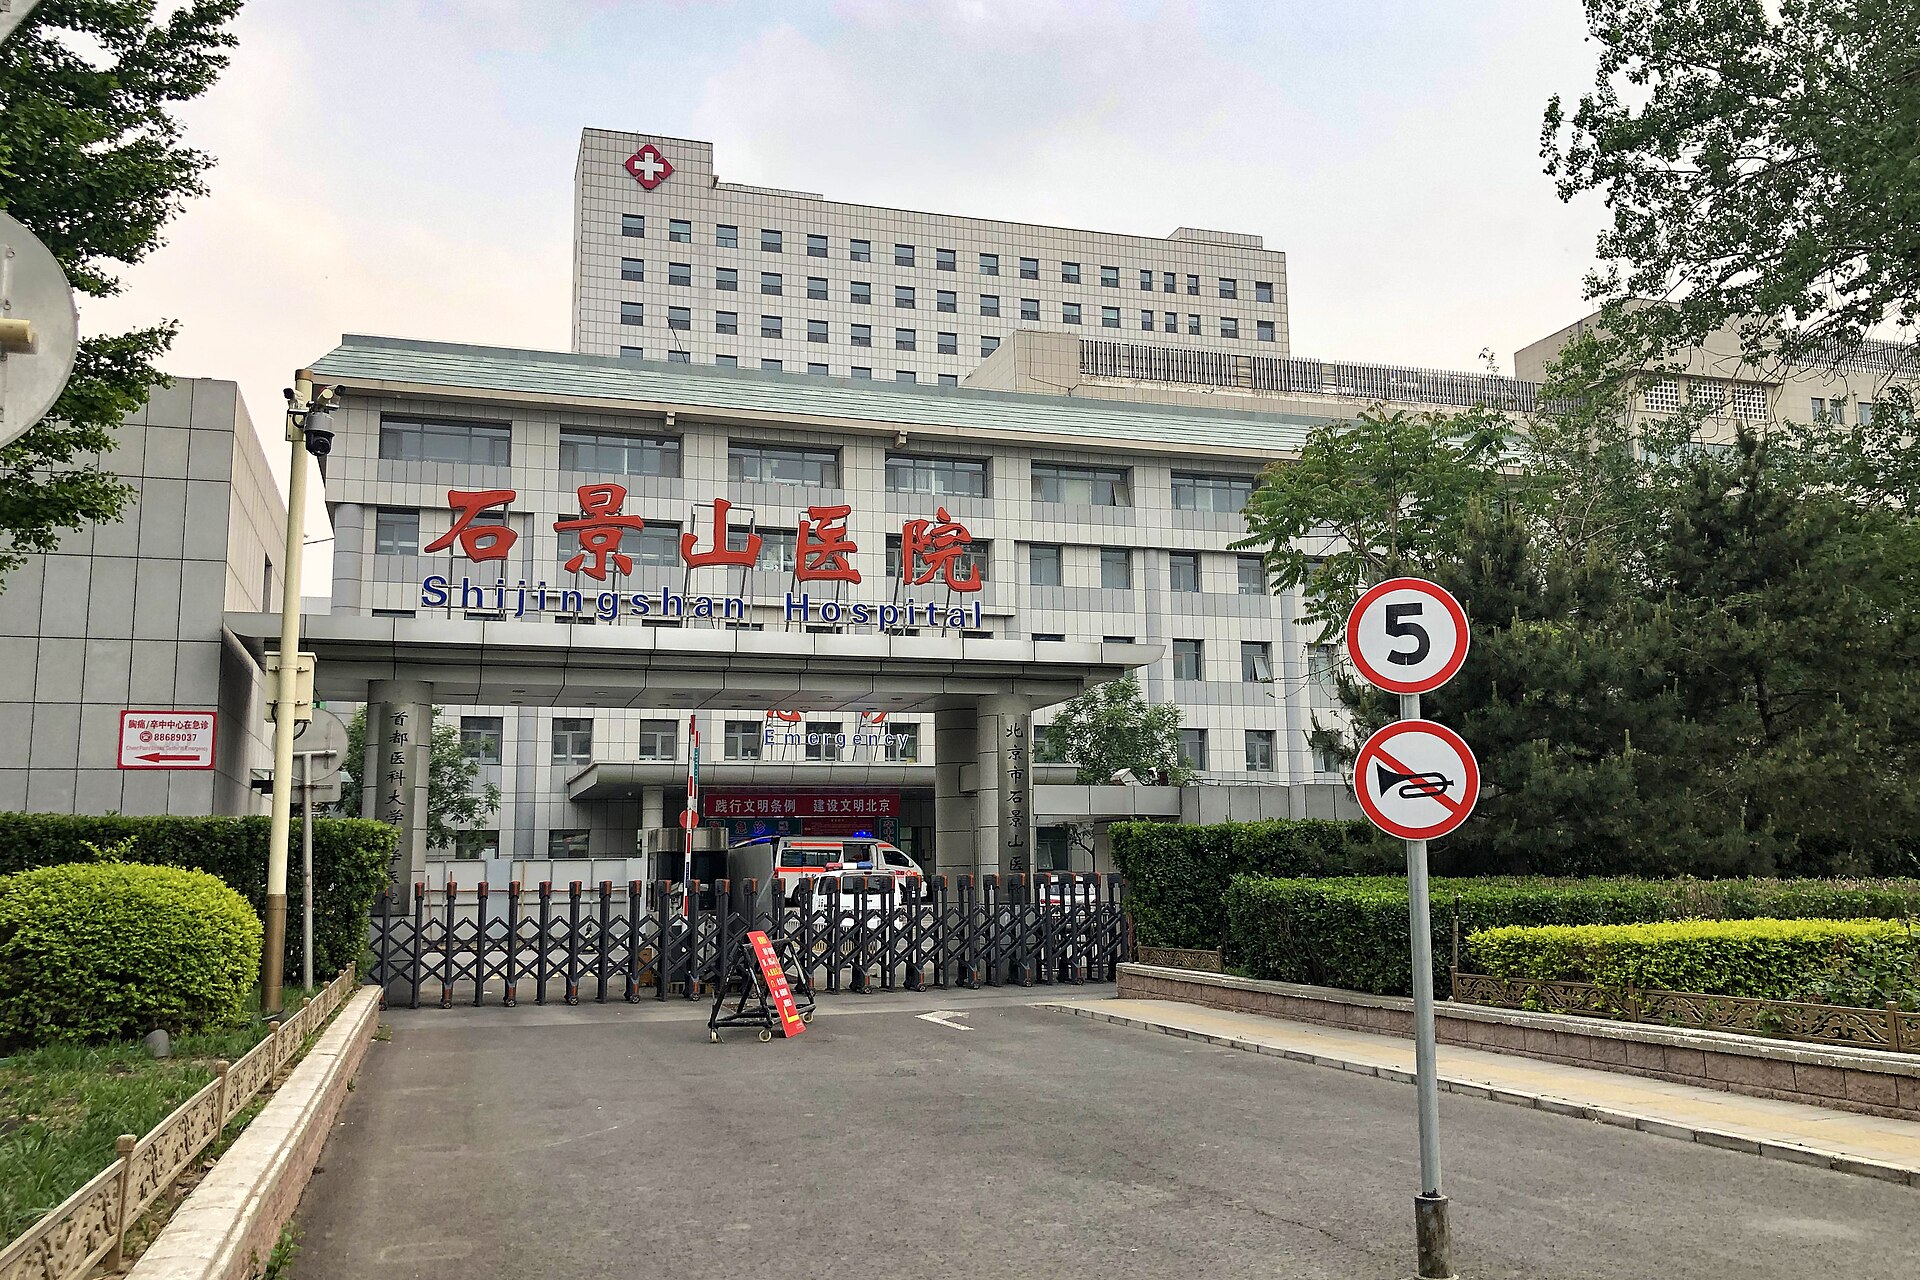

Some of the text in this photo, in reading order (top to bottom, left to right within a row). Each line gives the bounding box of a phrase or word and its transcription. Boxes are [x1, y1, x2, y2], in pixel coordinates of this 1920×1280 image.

[424, 483, 982, 592] 石景山医院
[421, 574, 982, 631] Shijingshan Hospital
[1385, 602, 1431, 666] 5
[154, 733, 197, 741] 88689037
[763, 728, 910, 749] Emergency
[715, 798, 890, 813] 践行文明条例 建设文明北京
[1005, 722, 1025, 892] 北京市石景山医
